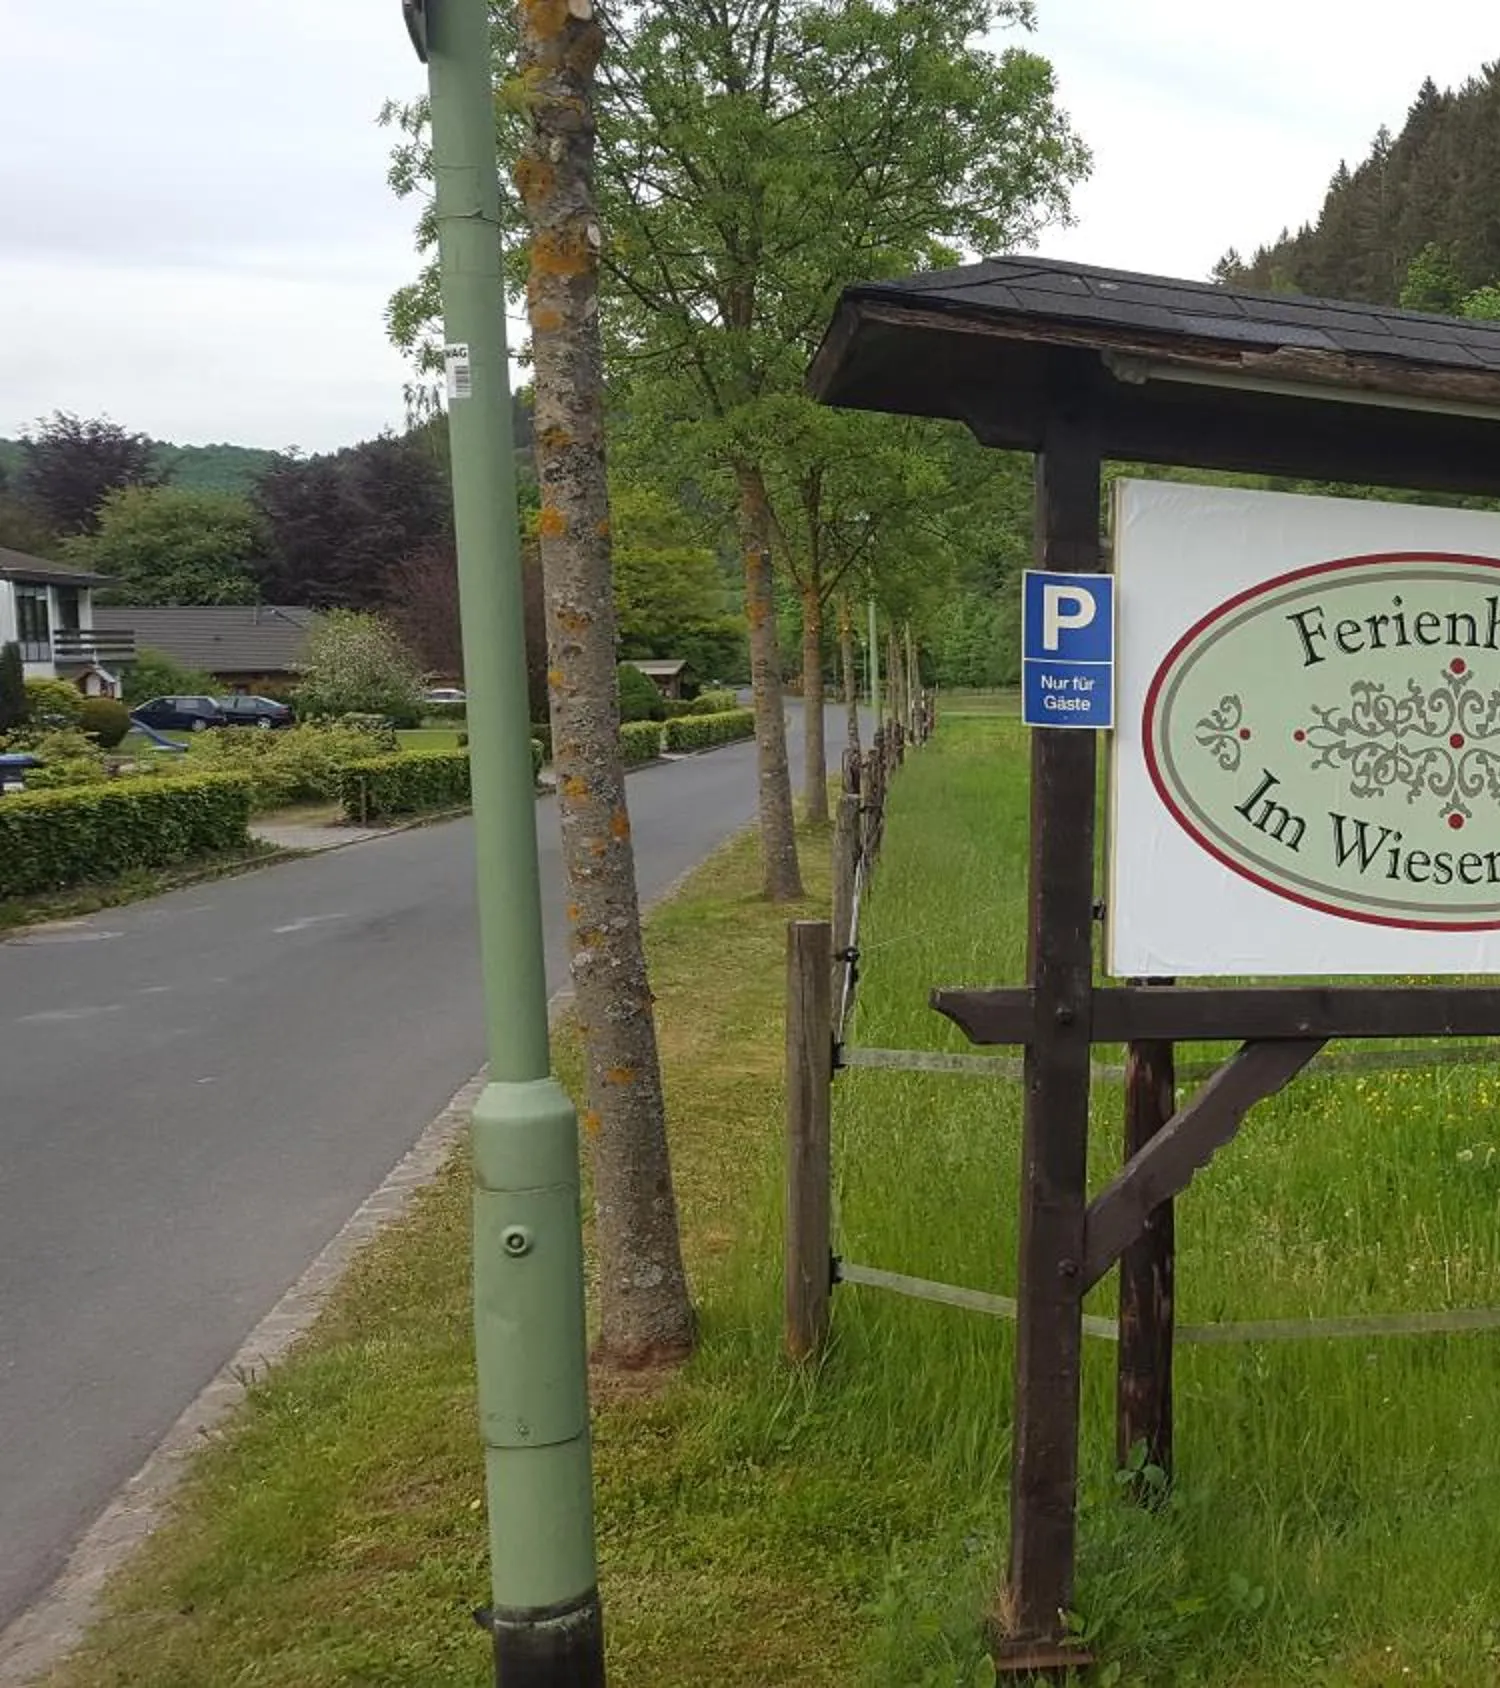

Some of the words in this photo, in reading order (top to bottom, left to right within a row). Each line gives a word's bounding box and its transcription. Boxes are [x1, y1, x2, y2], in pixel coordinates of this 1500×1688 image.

[1043, 584, 1096, 650] P
[1041, 675, 1069, 690] Nur
[1073, 676, 1095, 691] für
[1043, 695, 1091, 711] Gäste
[1234, 768, 1306, 852] Im
